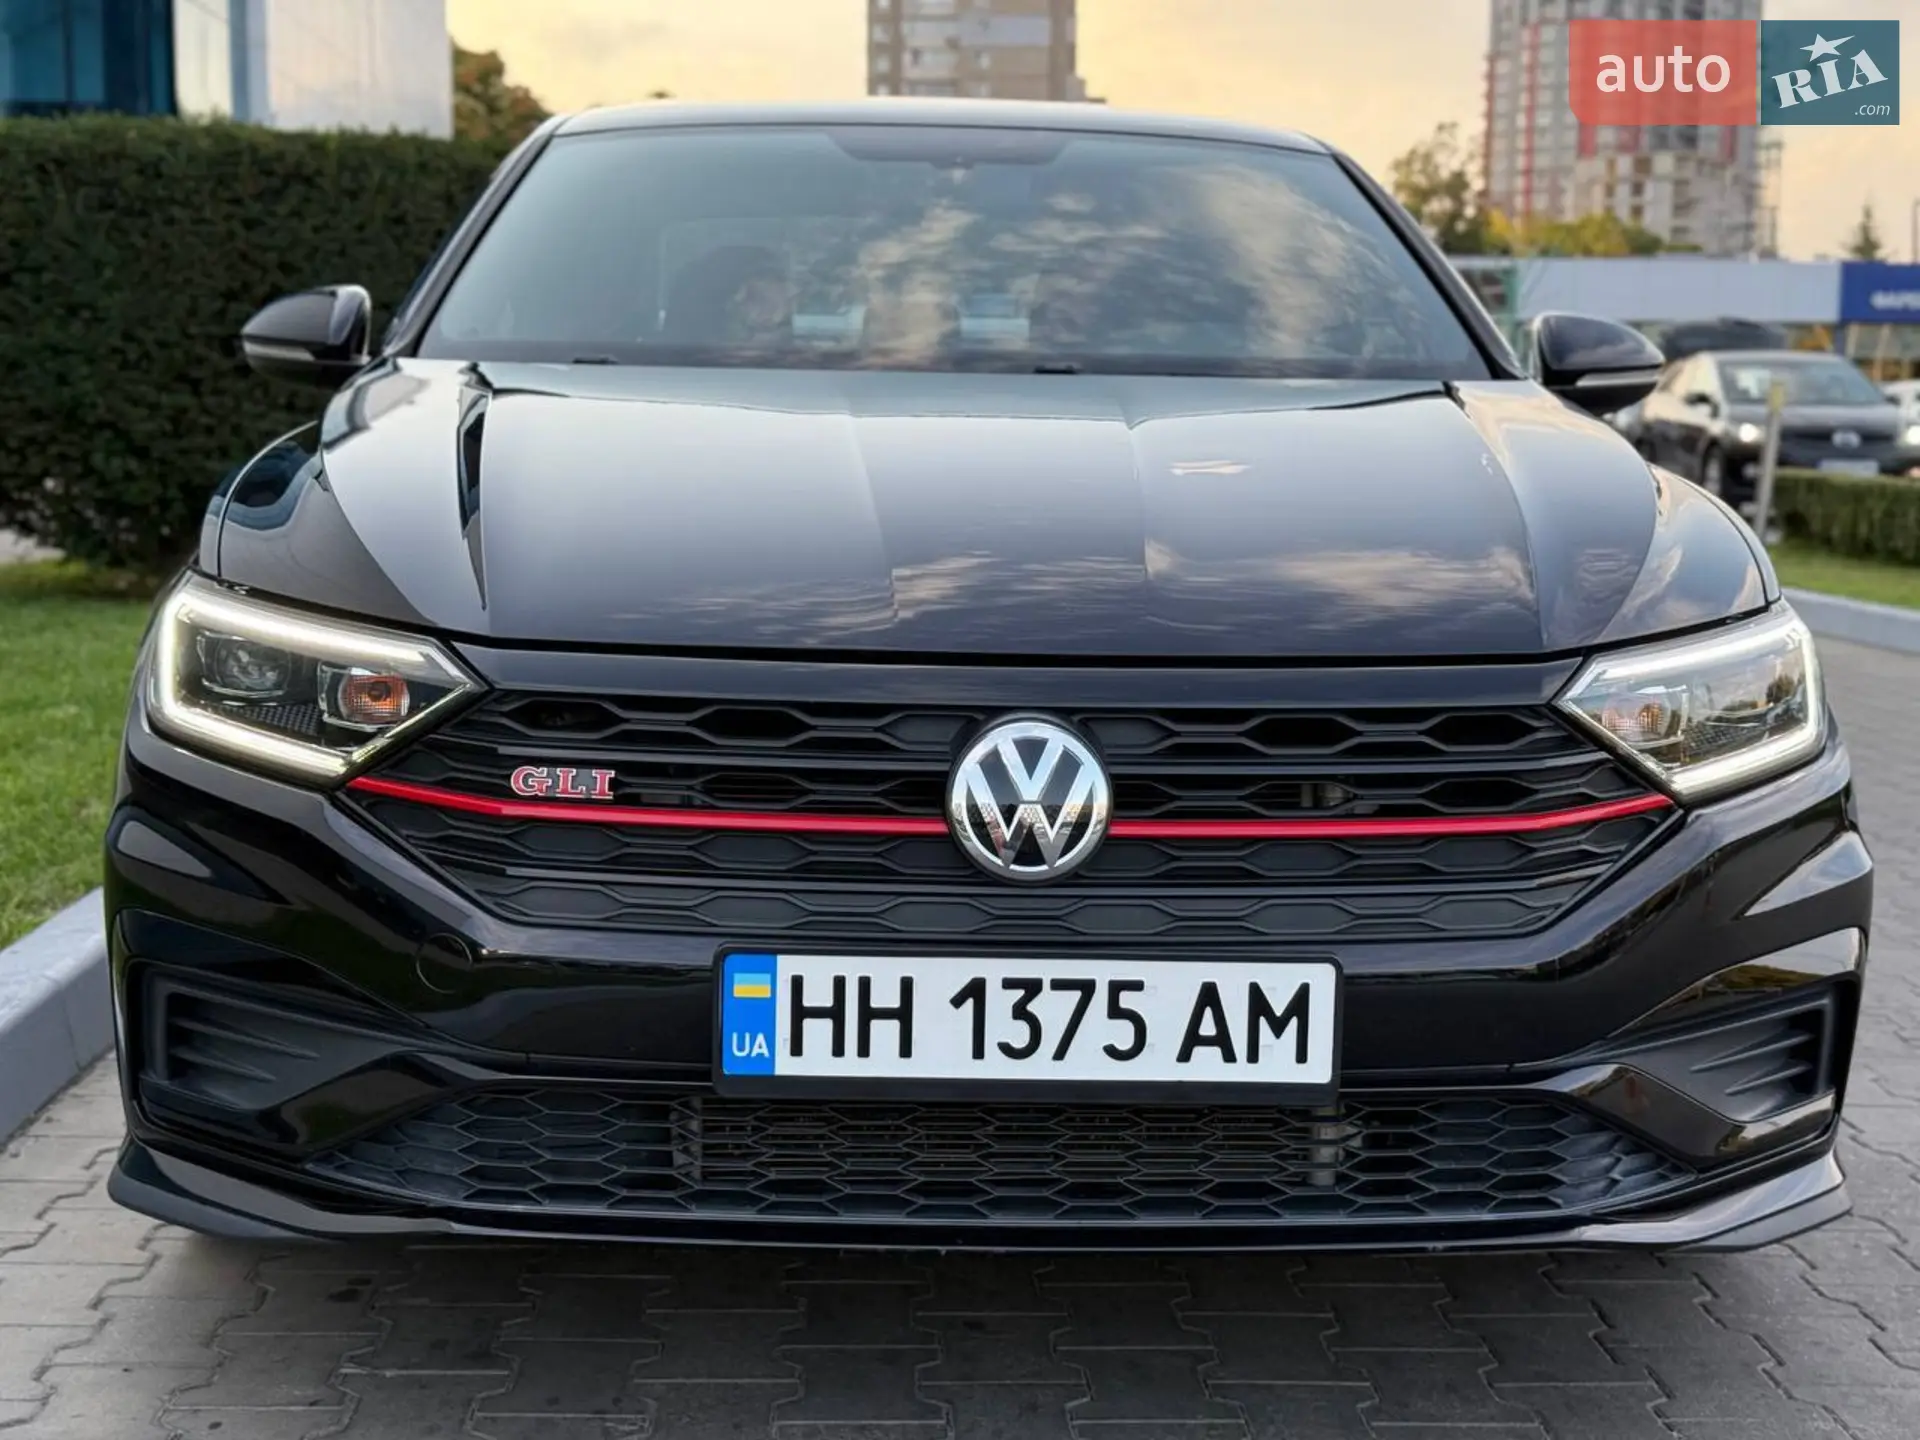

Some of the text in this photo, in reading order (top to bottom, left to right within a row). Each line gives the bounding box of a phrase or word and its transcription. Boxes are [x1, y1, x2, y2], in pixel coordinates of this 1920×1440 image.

[510, 765, 616, 799] GLI
[789, 974, 1310, 1065] HH 1375 AM
[732, 1032, 769, 1058] UA
